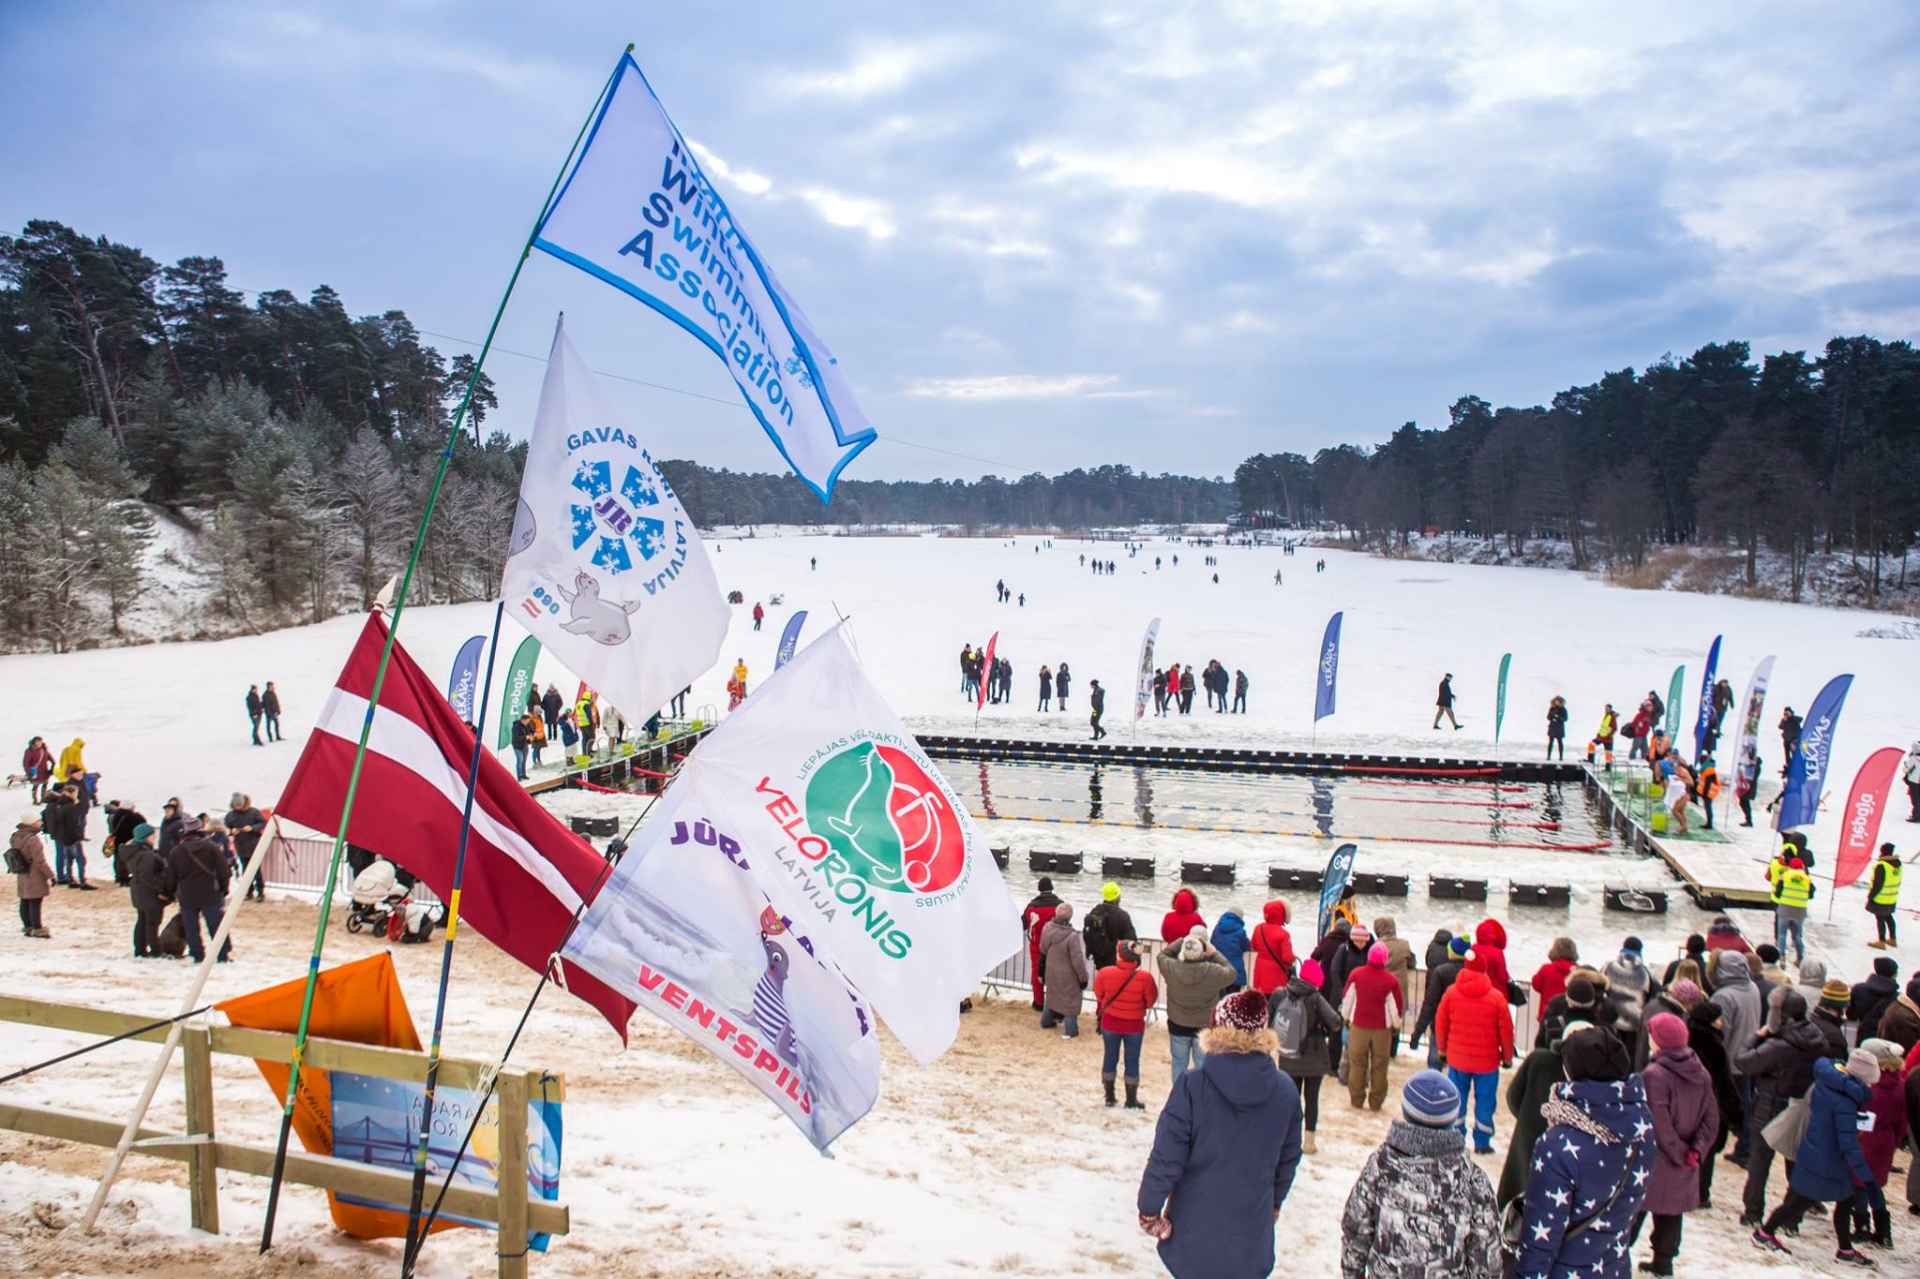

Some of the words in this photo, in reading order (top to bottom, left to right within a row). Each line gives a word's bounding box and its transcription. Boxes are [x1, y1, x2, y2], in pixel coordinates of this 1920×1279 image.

[618, 229, 794, 426] Association
[567, 426, 638, 450] GAVAS
[642, 519, 687, 596] LATVIJA
[594, 496, 633, 536] JR
[796, 737, 849, 781] LIEPĀJAS
[929, 768, 944, 787] UN
[755, 776, 912, 960] VELORONIS
[774, 846, 837, 923] LATVIJA
[915, 891, 957, 908] KLUBS
[637, 964, 812, 1115] VENTSPILS
